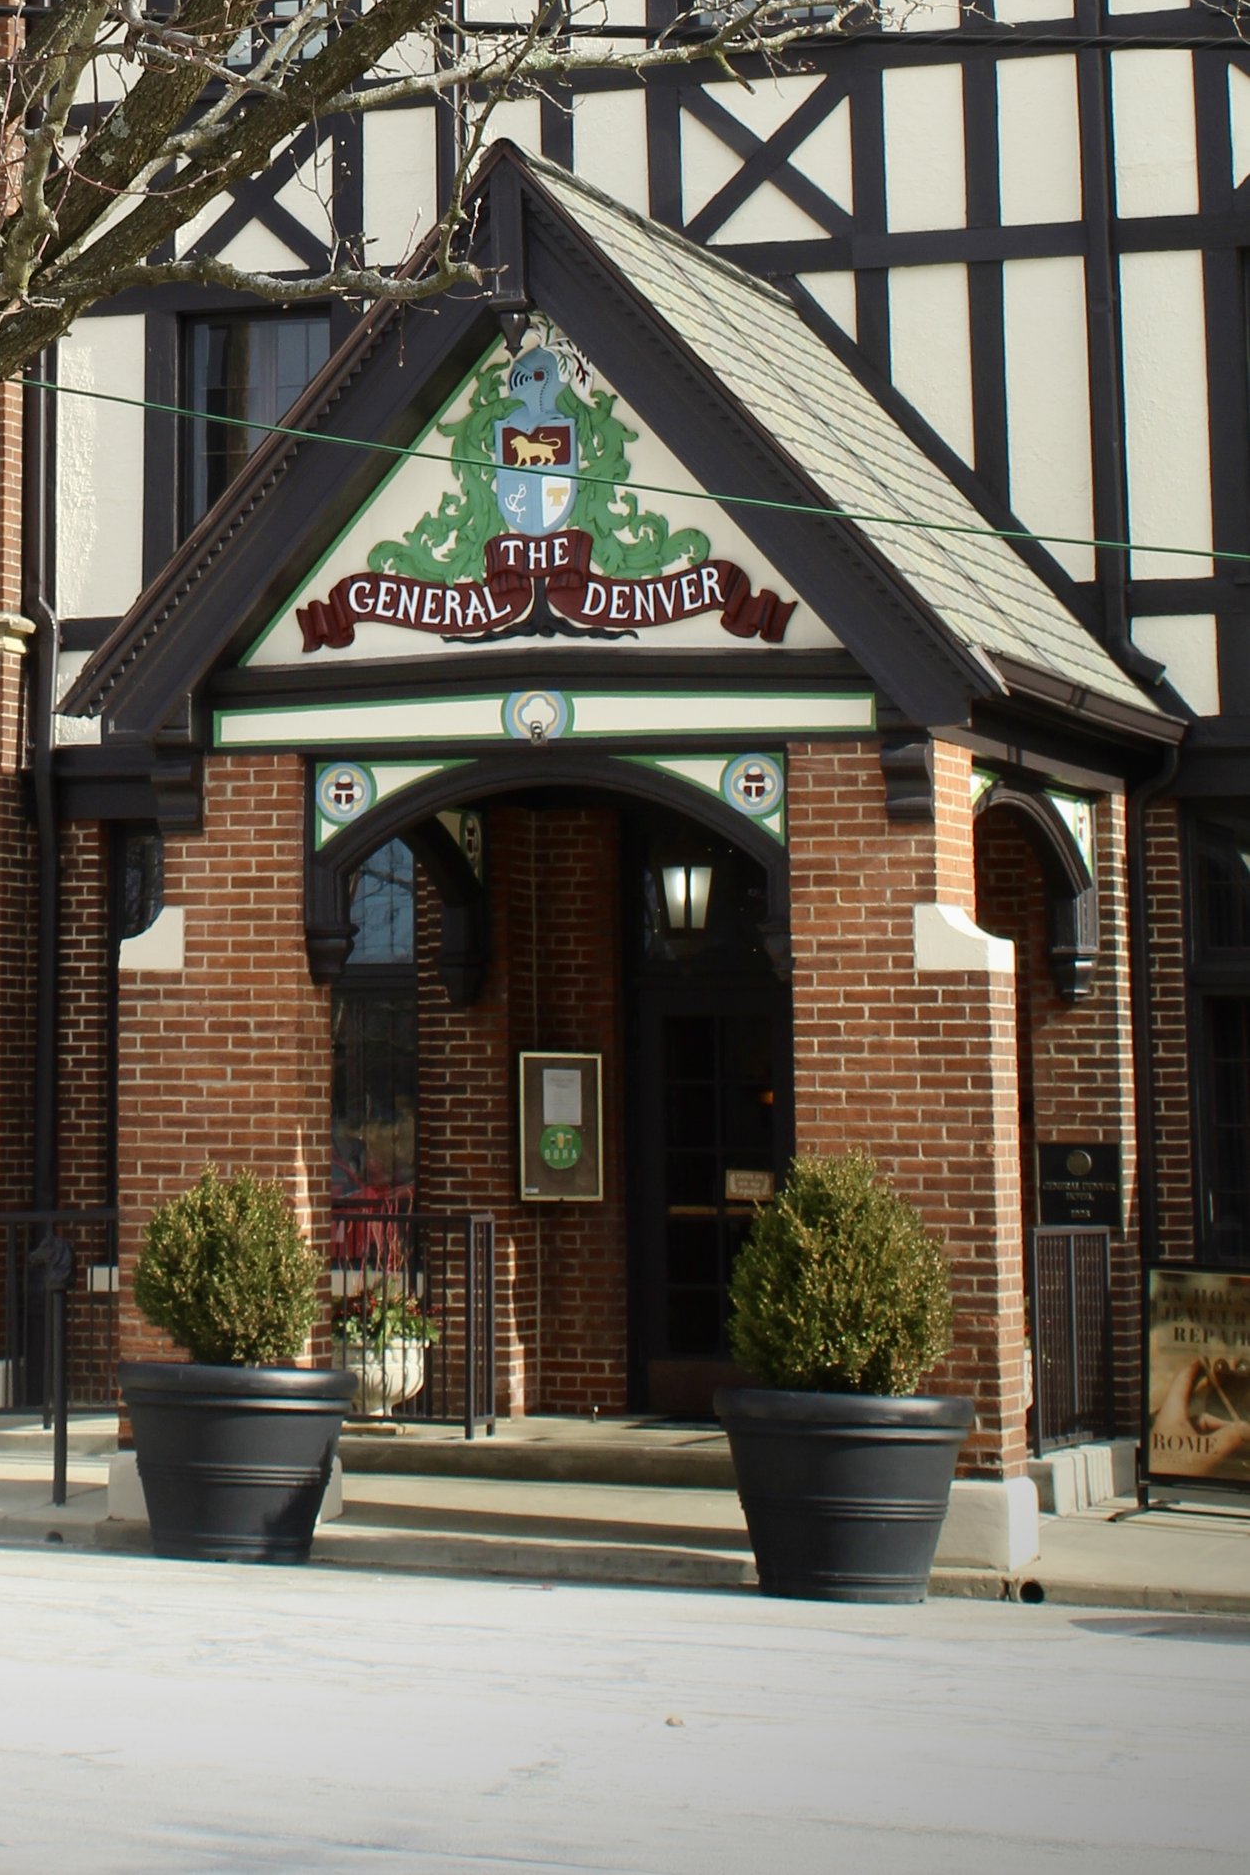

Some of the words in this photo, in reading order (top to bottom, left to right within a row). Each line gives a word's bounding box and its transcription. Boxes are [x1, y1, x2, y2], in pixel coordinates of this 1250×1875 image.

[500, 537, 569, 570] THE
[348, 581, 512, 628] GENERAL
[581, 566, 725, 623] DENVER
[1153, 1432, 1218, 1455] ROME
